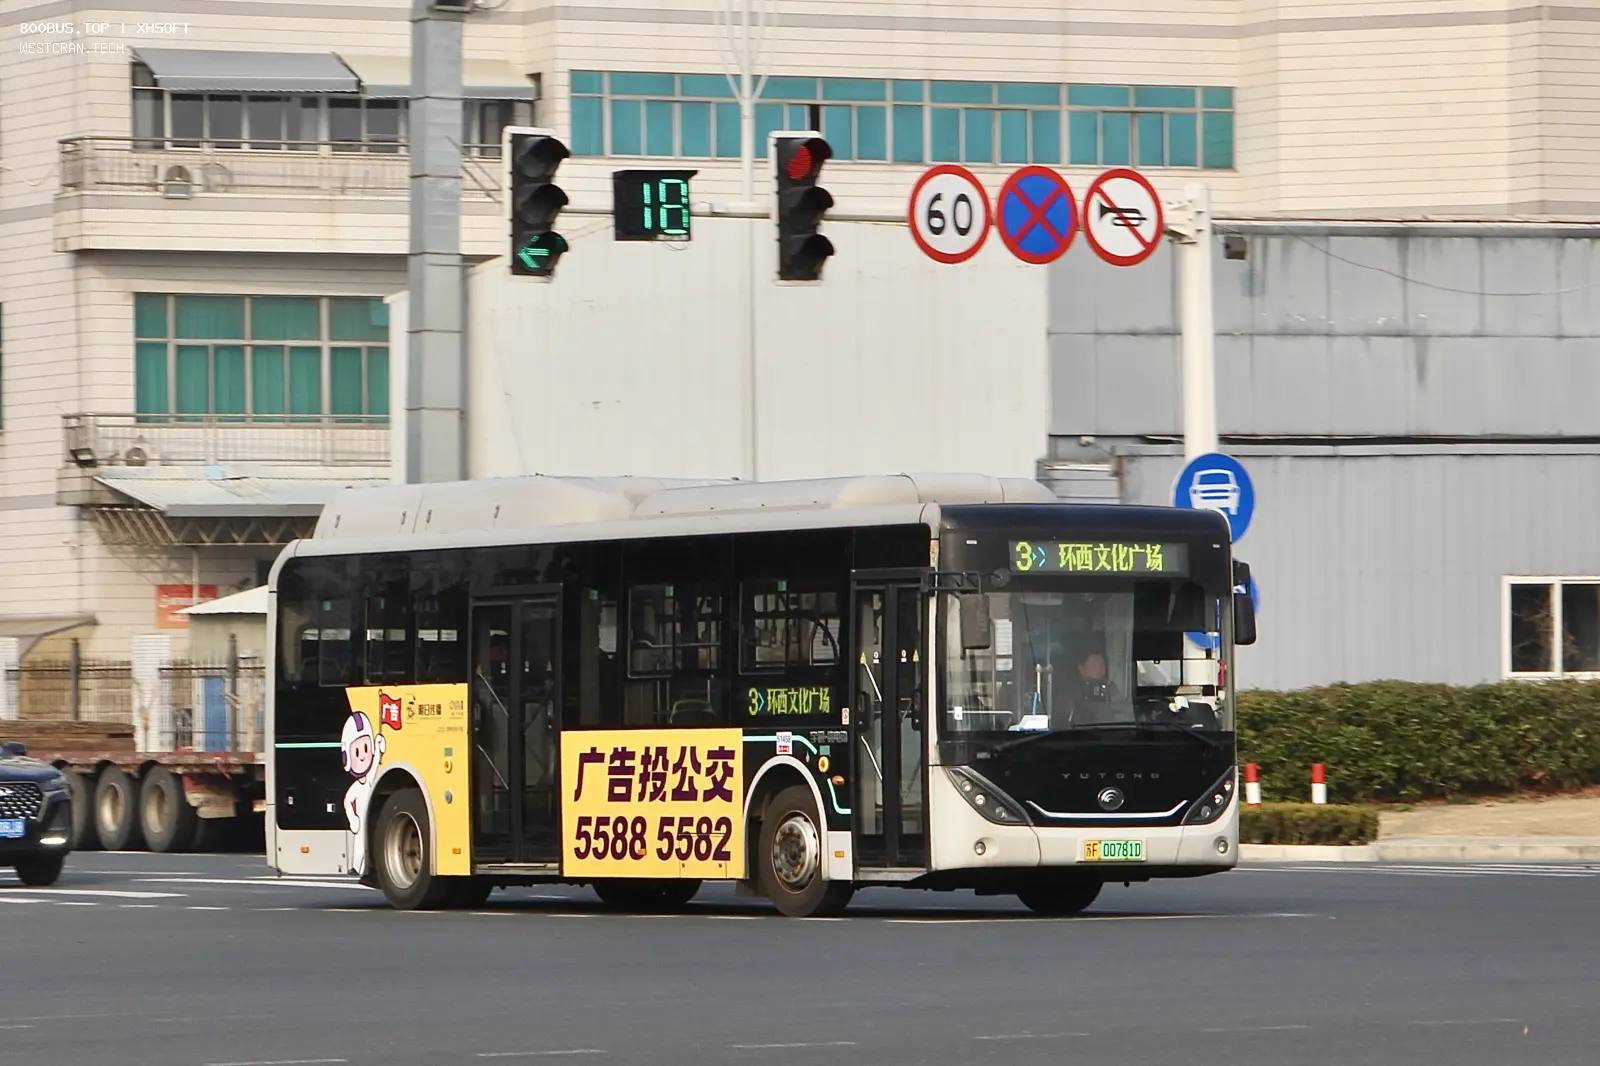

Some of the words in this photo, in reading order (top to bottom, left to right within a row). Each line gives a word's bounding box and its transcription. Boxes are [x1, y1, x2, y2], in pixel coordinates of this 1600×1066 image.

[642, 178, 691, 235] 18
[927, 192, 973, 236] 60
[1015, 541, 1032, 571] 3
[1059, 543, 1164, 572] 环西文化广场
[748, 687, 758, 715] 3
[767, 687, 830, 715] 环西文化广场
[574, 746, 736, 802] 广告投公交
[574, 816, 647, 860] 5588
[656, 816, 733, 861] 5582
